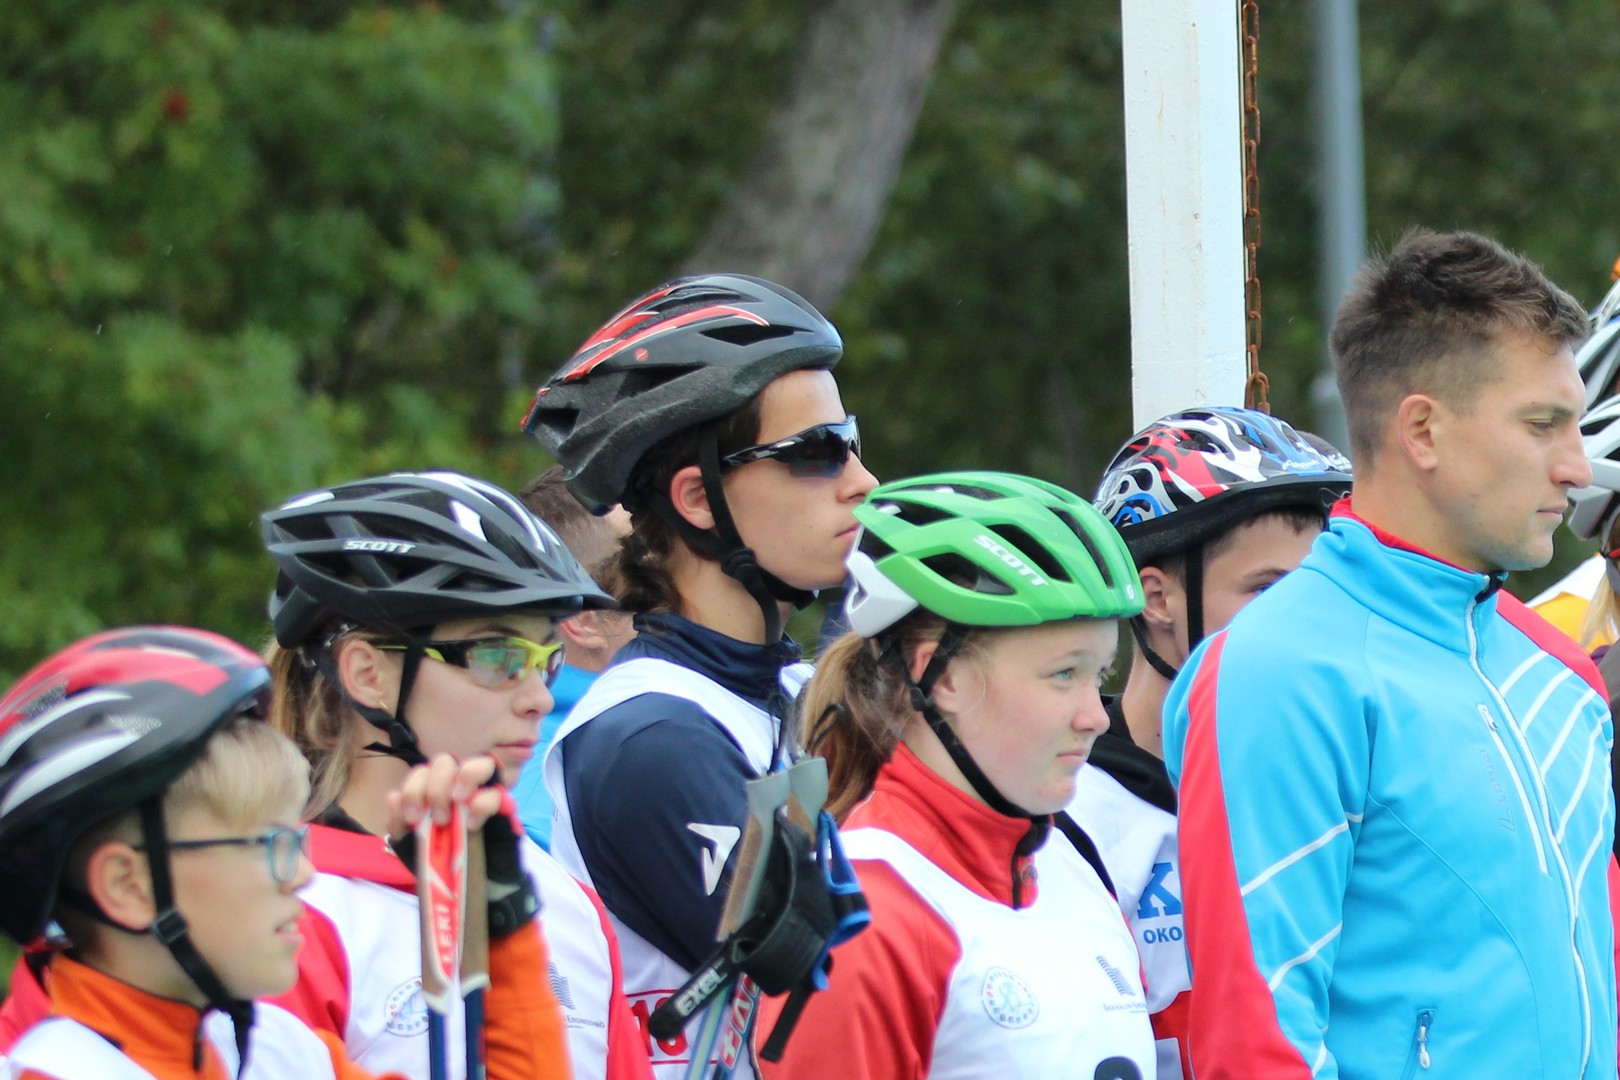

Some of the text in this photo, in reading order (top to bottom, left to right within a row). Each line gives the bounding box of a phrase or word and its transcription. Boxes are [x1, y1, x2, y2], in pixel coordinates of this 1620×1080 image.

[344, 540, 416, 554] SCOTT
[973, 534, 1050, 587] SCOTT
[436, 903, 454, 962] LEKI
